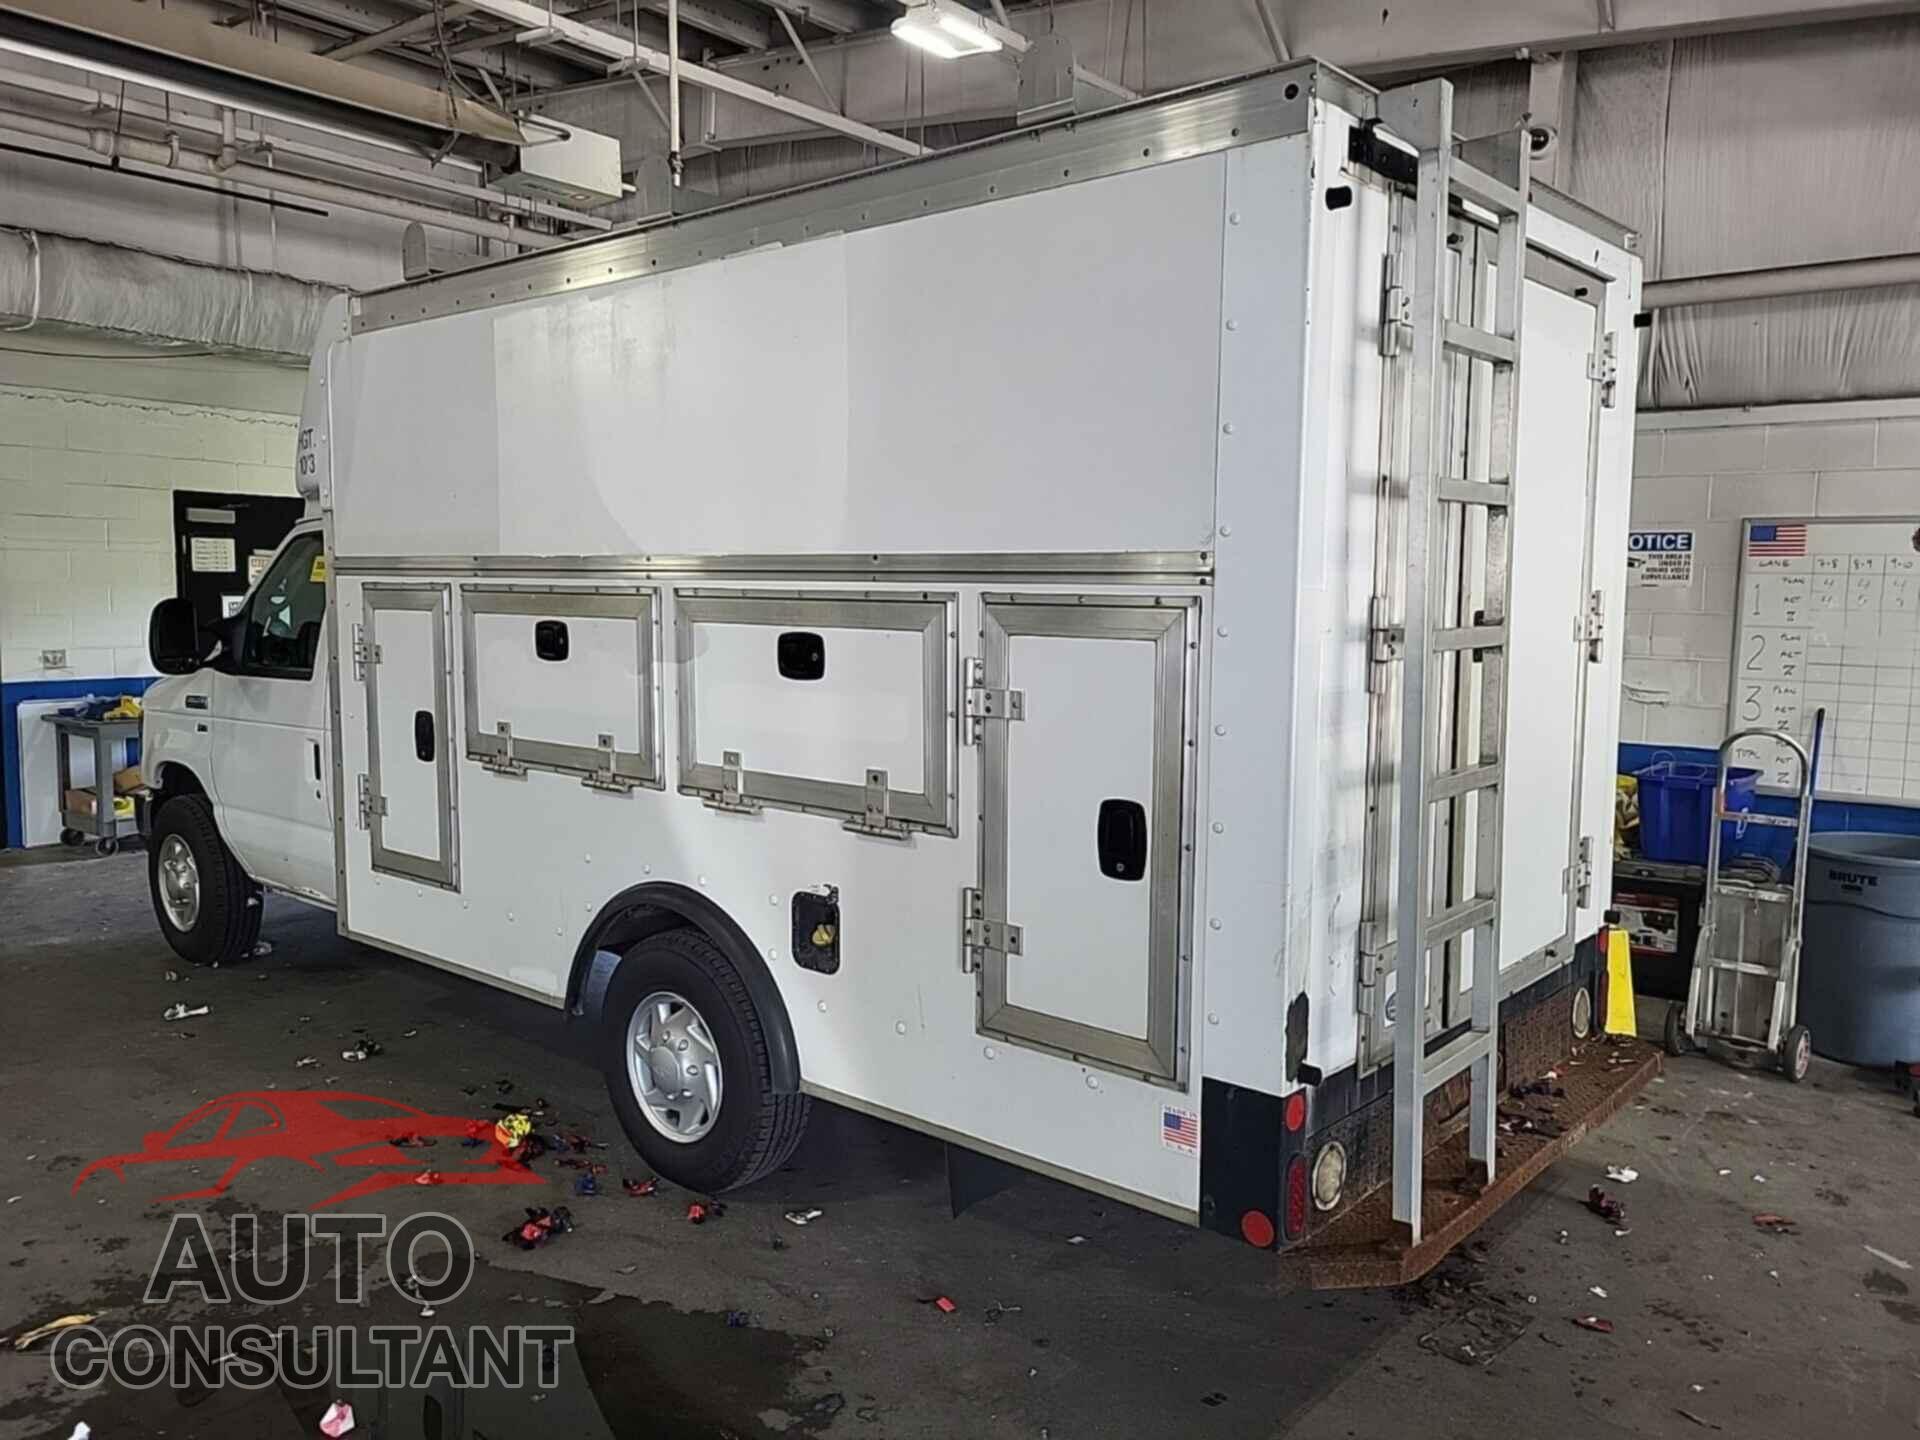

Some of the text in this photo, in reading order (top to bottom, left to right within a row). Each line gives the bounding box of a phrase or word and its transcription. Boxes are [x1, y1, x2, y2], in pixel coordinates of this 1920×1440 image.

[1629, 533, 1689, 550] OTICE
[1746, 634, 1766, 671] 2
[1742, 685, 1762, 721] 3
[1829, 869, 1878, 886] BRUTE
